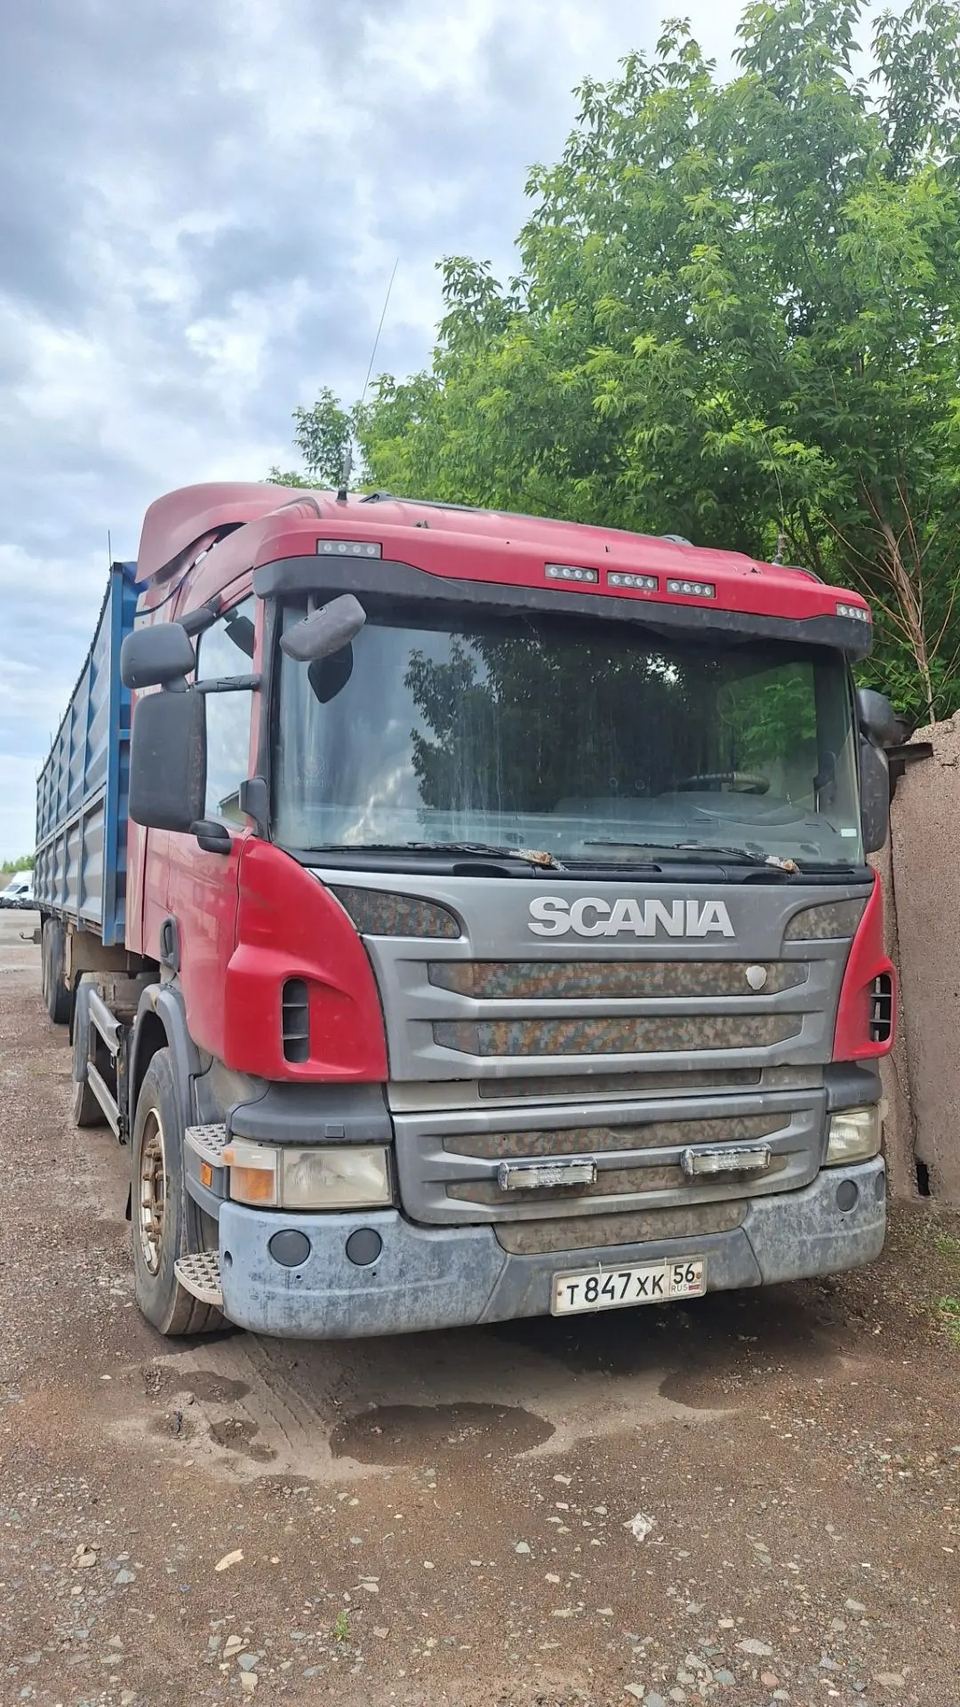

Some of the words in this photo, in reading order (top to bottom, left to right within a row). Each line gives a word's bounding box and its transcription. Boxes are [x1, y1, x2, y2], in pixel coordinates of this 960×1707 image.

[528, 896, 735, 937] SCANIA
[673, 1264, 695, 1284] 56
[671, 1284, 688, 1292] RUS
